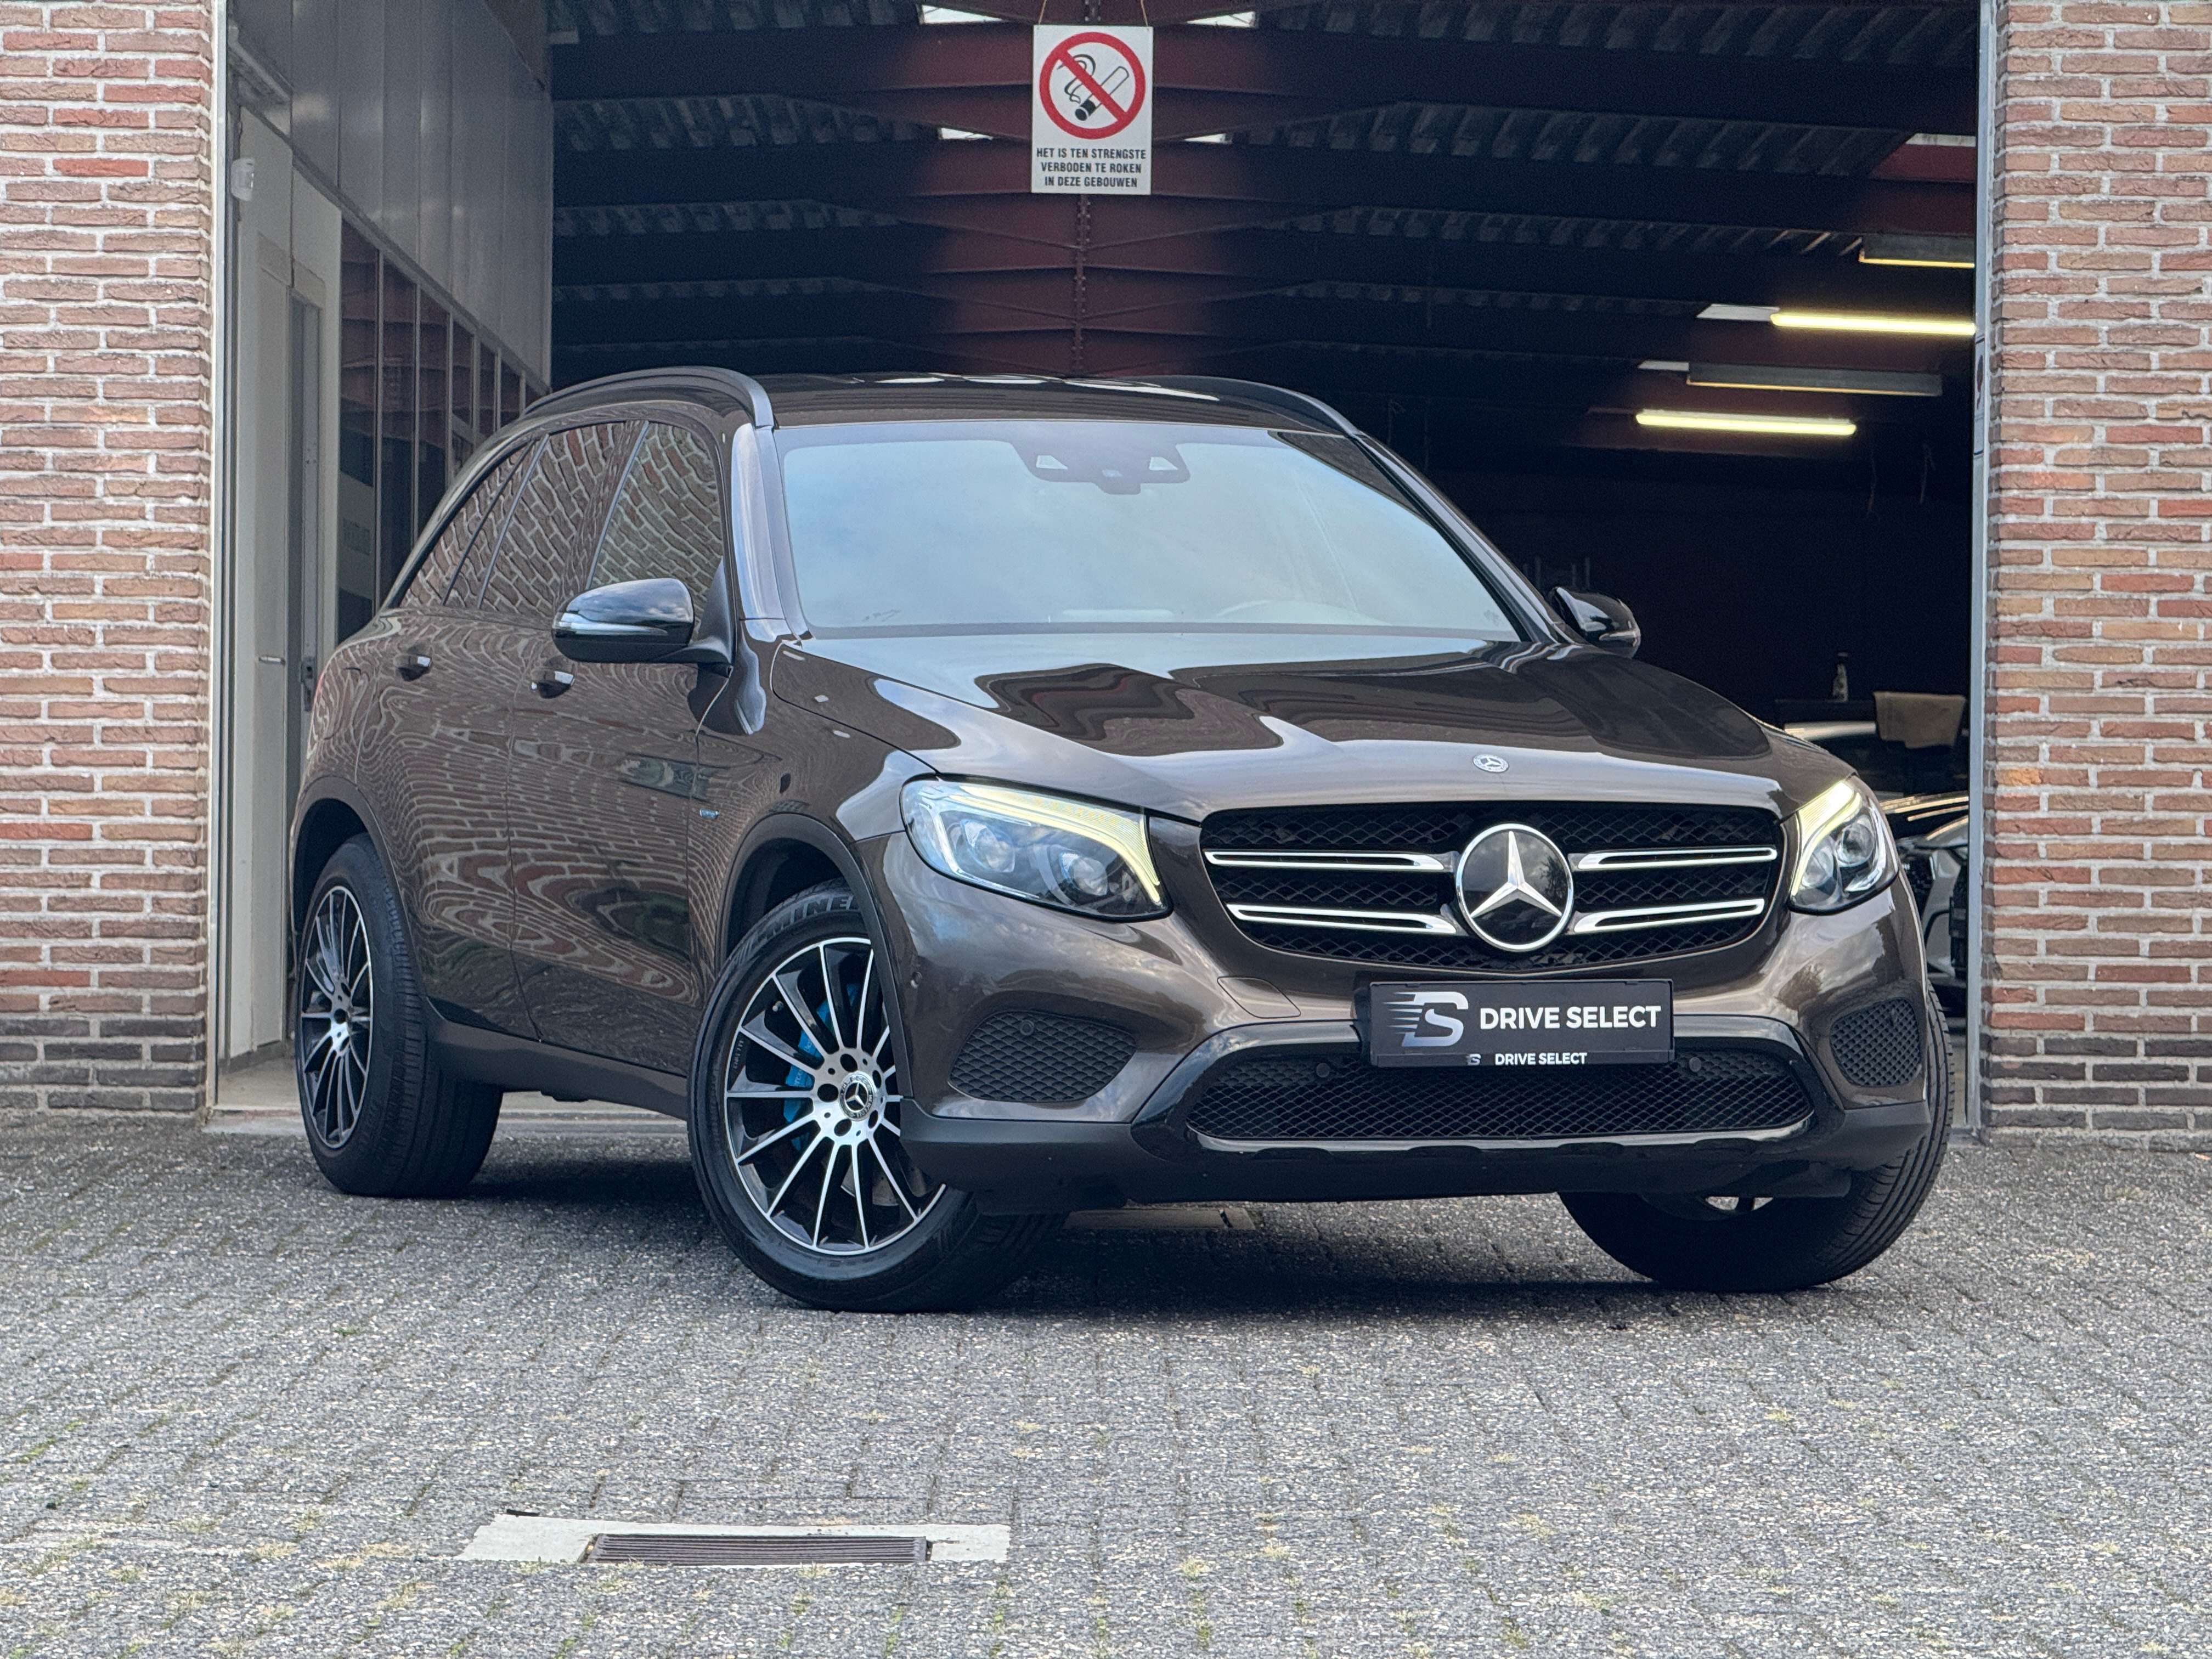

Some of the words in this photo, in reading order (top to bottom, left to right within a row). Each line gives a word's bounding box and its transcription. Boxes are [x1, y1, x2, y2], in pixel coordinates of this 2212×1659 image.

[1036, 148, 1054, 158] HET
[1058, 148, 1067, 158] IS
[1070, 148, 1088, 159] TEN
[1091, 148, 1146, 160] STRENGSTE
[1041, 162, 1092, 172] VERBODEN
[1095, 162, 1106, 173] TE
[1110, 163, 1142, 173] ROKEN
[1045, 176, 1054, 187] IN
[1057, 176, 1081, 187] DEZE
[1084, 177, 1137, 188] GEBOUWEN
[1480, 1007, 1560, 1030] DRIVE
[1566, 1006, 1662, 1029] SELECT
[1495, 1053, 1536, 1065] DRIVE
[1538, 1052, 1588, 1065] SELECT
